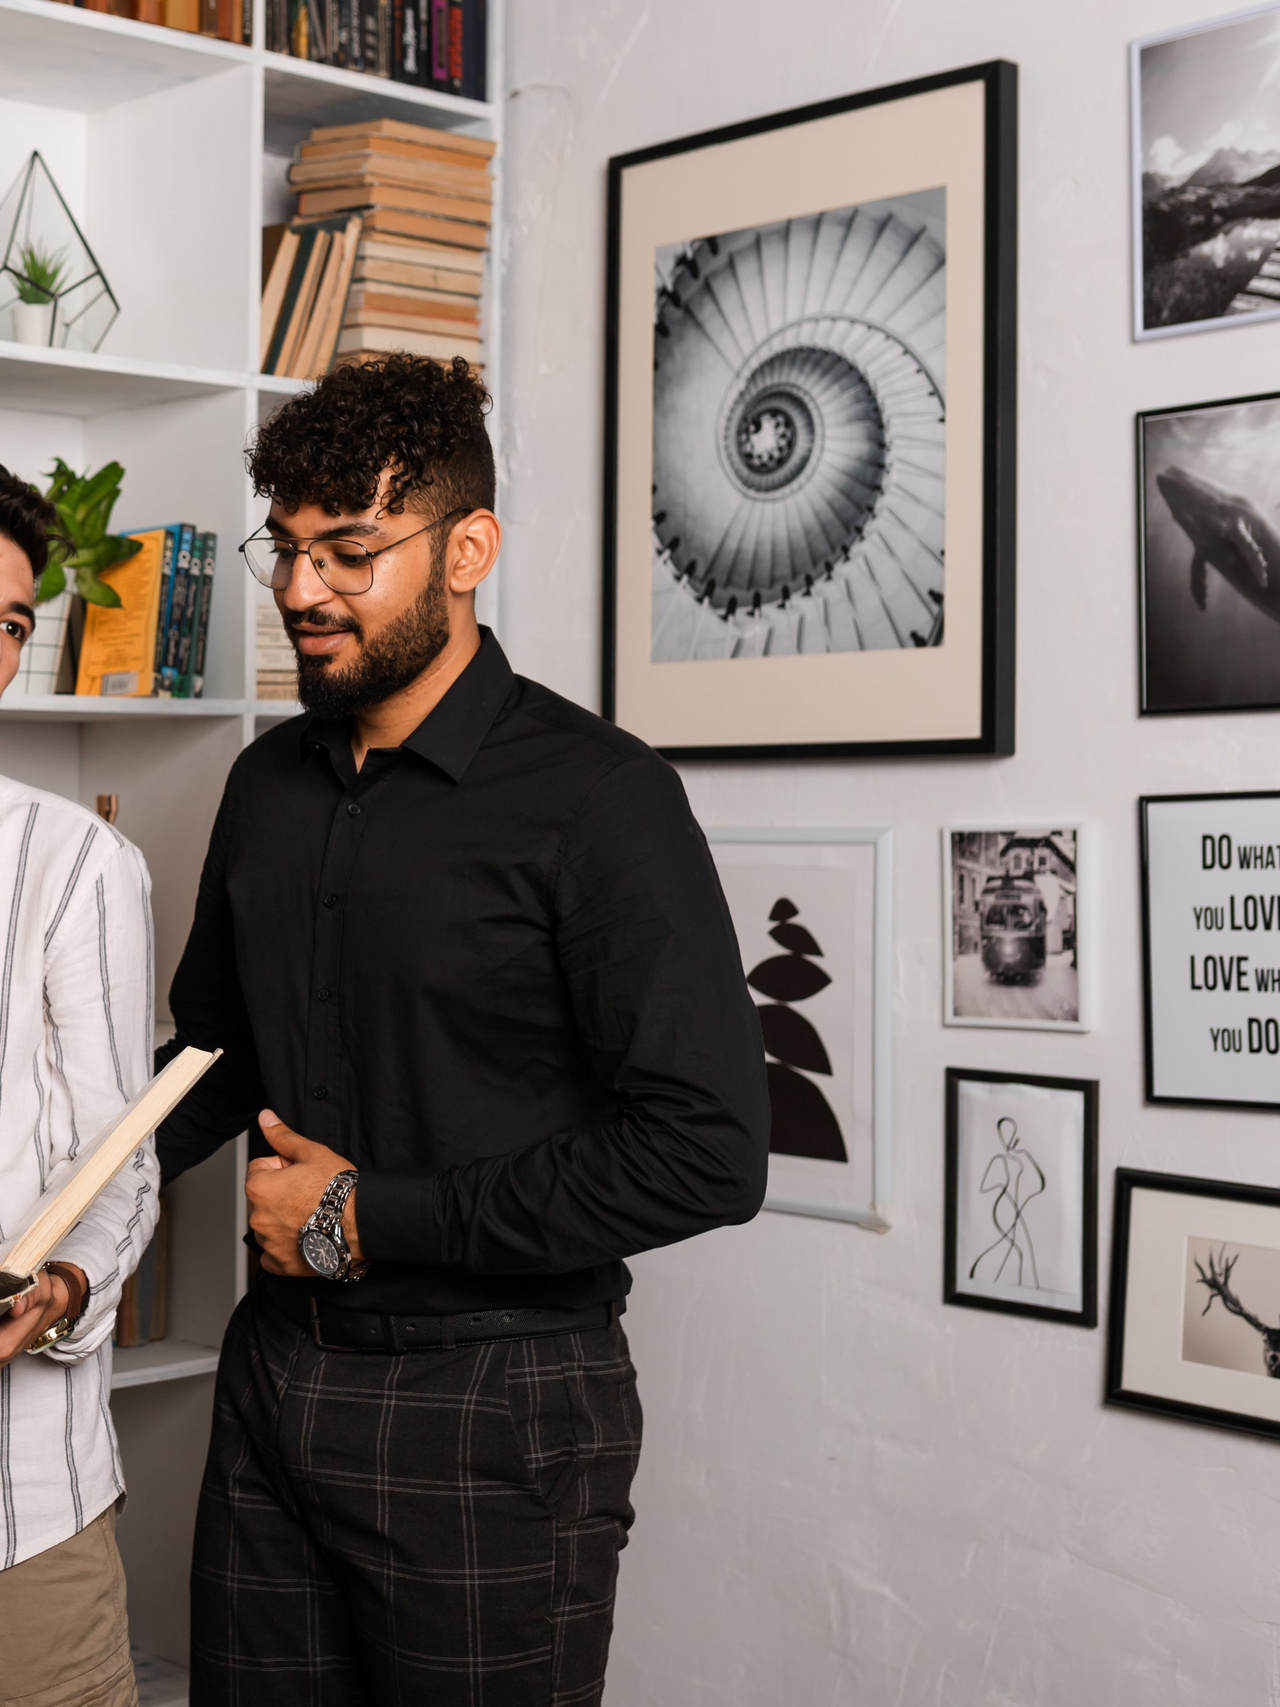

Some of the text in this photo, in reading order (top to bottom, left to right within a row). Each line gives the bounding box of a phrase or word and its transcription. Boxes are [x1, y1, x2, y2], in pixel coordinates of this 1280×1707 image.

[1202, 834, 1232, 870] DO
[1193, 895, 1280, 931] YOU LOV
[1191, 955, 1250, 992] LOVE
[1210, 1017, 1280, 1055] YOU DO
